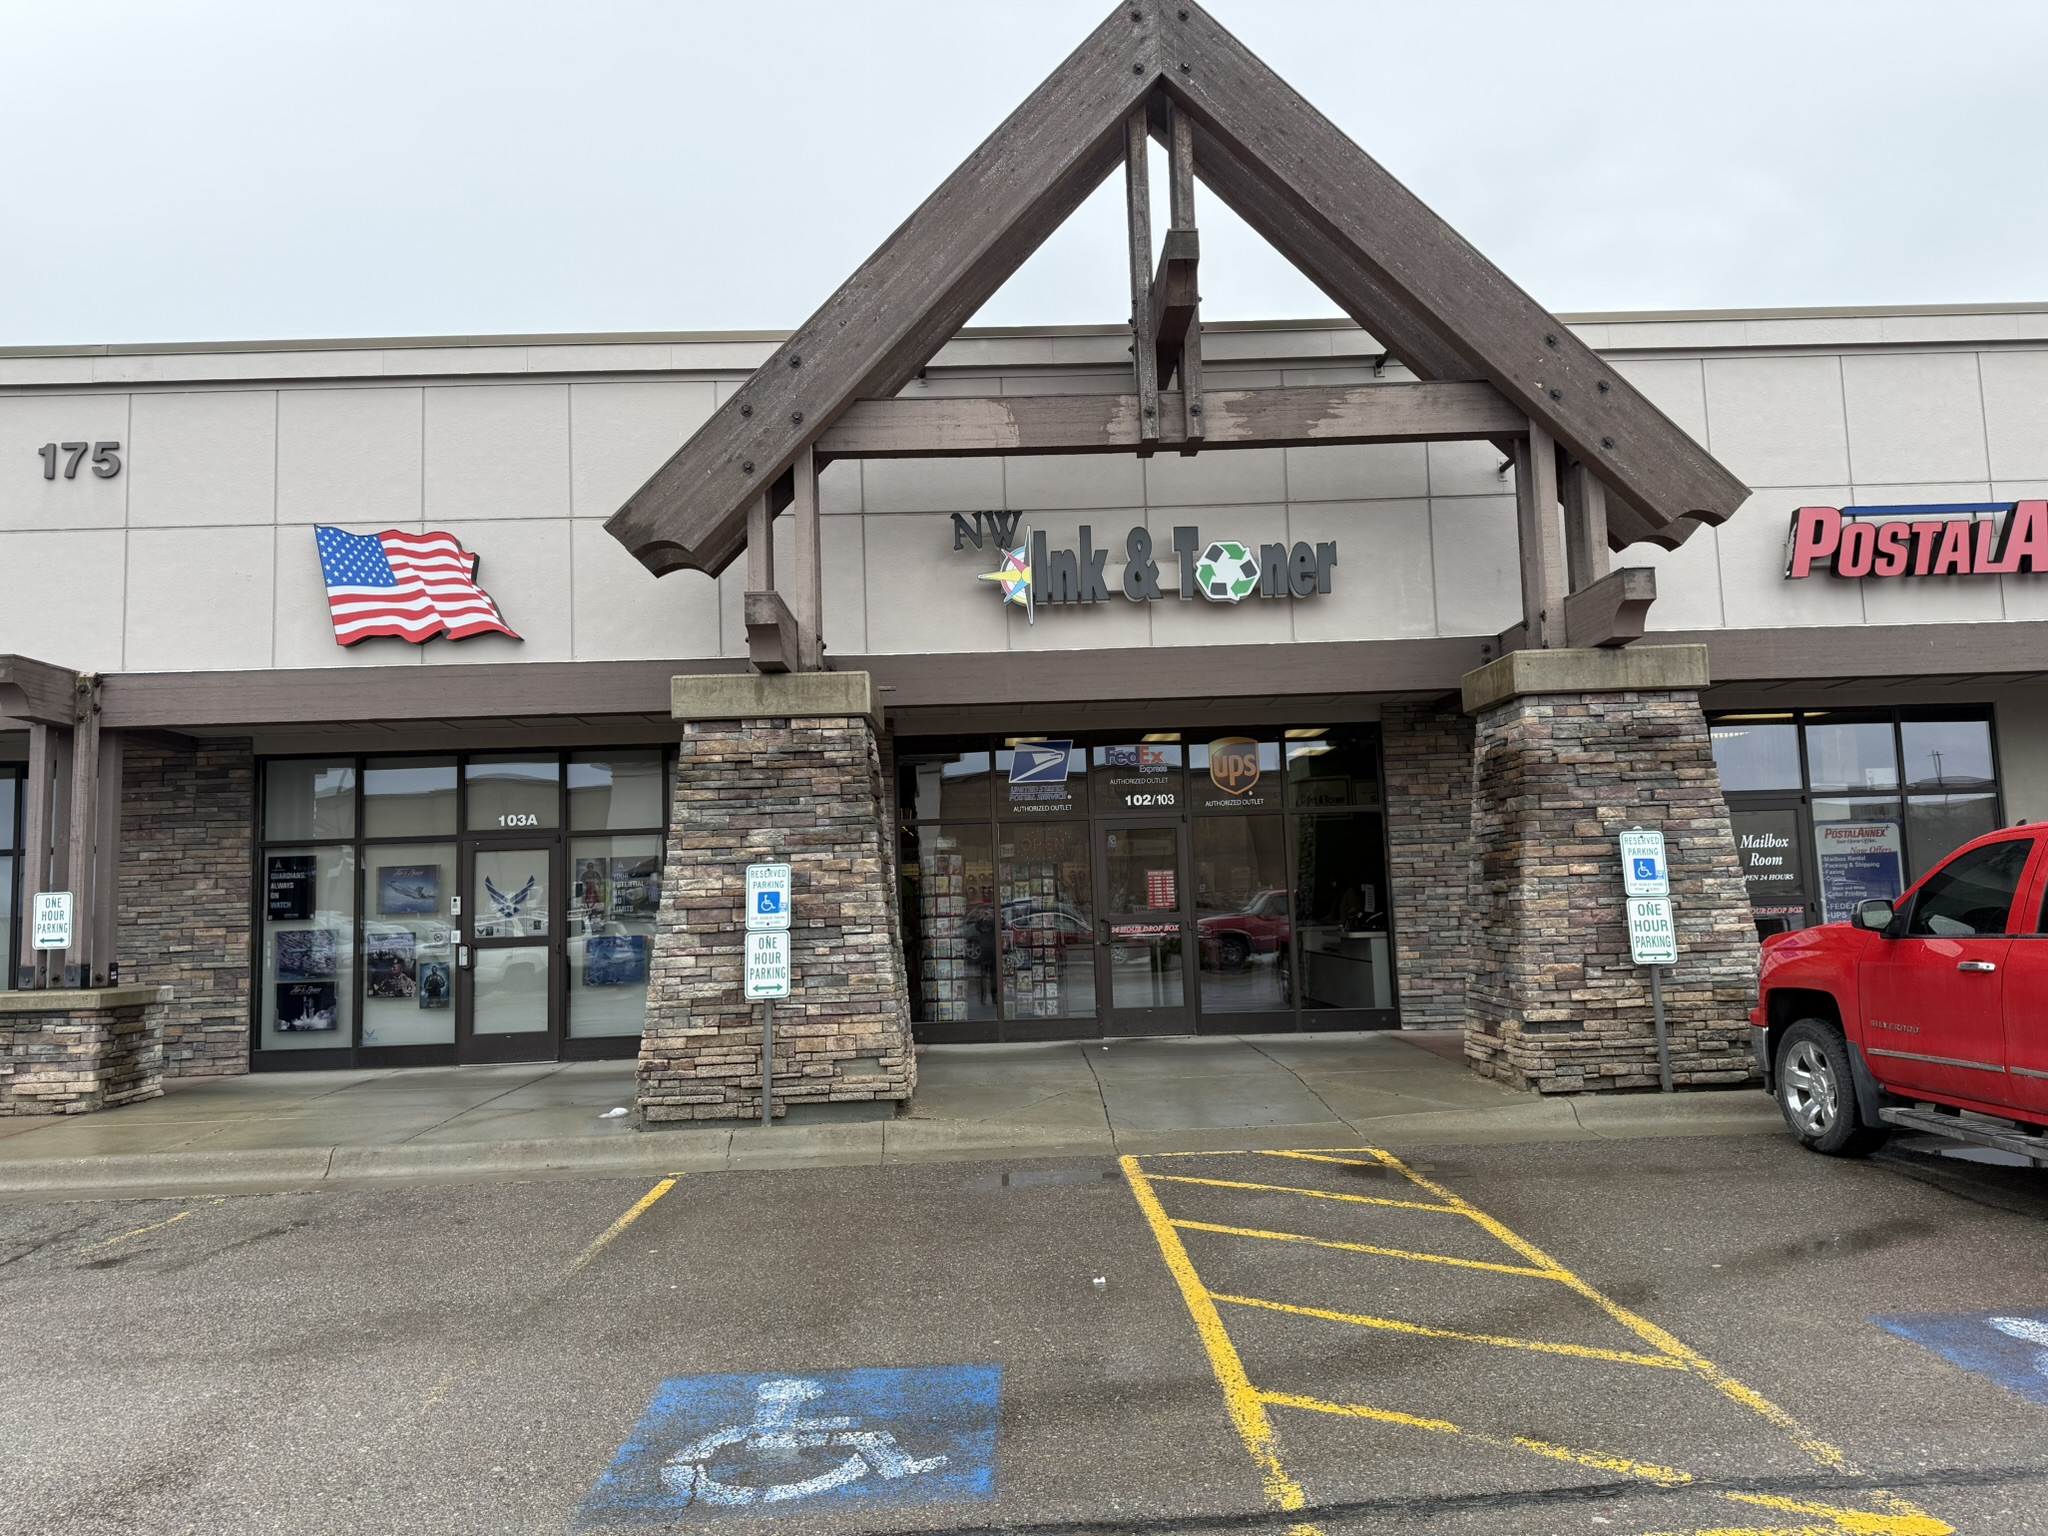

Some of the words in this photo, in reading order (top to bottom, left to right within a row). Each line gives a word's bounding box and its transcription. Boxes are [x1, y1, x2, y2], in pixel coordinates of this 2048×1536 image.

[38, 441, 121, 480] 175
[951, 511, 1022, 550] NW
[1031, 525, 1109, 604] Ink
[1123, 526, 1163, 602] &
[1104, 745, 1165, 766] FedEx
[1139, 765, 1168, 774] Express
[1213, 754, 1257, 786] ups
[1146, 776, 1169, 784] OUTLET
[1125, 793, 1175, 806] 102/103
[498, 814, 538, 827] 103A
[1624, 836, 1660, 845] RESERVED
[1740, 833, 1789, 849] Mailbox
[1628, 847, 1659, 856] PARKING
[1749, 852, 1783, 866] Room
[270, 872, 307, 880] GUARDIANS:
[612, 872, 629, 880] YOUR
[750, 869, 786, 878] RESERVED
[1769, 873, 1794, 881] HOURS
[270, 882, 295, 890] ALWAYS
[612, 880, 645, 888] POTENTIAL
[752, 880, 785, 890] PARKING
[270, 892, 280, 900] ON
[45, 898, 62, 908] ONE
[270, 901, 291, 909] WATCH
[612, 905, 634, 913] LIMITS
[1637, 904, 1662, 917] ONE
[41, 910, 65, 921] HOUR
[37, 923, 68, 934] PARKING
[1163, 924, 1180, 932] BOX
[1634, 919, 1669, 932] HOUR
[758, 937, 778, 949] ONE
[1635, 936, 1671, 948] PARKING
[754, 952, 781, 965] HOUR
[749, 967, 786, 980] PARKING
